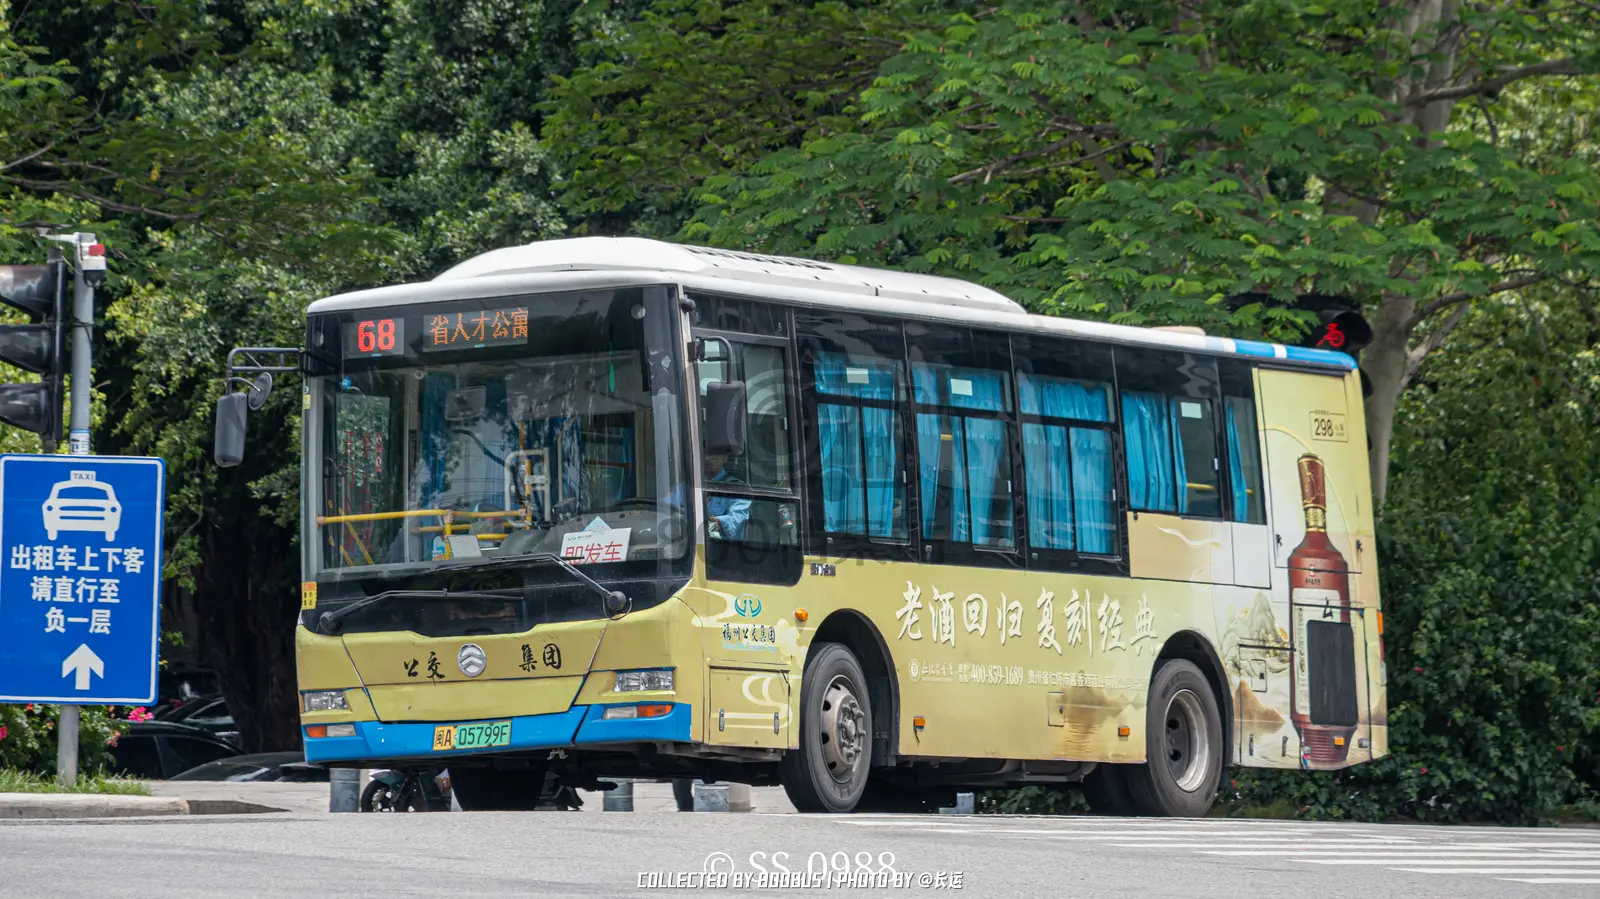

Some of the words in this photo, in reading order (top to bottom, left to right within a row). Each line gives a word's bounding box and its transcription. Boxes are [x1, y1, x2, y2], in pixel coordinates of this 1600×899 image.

[358, 319, 395, 352] 68
[429, 307, 528, 346] 省人才公寓
[1314, 418, 1333, 437] 298
[73, 472, 94, 480] TAXI
[10, 544, 145, 573] 出租车上下客
[565, 541, 622, 565] 即发车
[30, 575, 120, 603] 请直行至
[44, 606, 111, 635] 负一层
[722, 622, 776, 643] 福州公交集团
[403, 651, 446, 685] 公交
[518, 643, 562, 673] 集团
[971, 663, 1024, 686] 400-859-1689
[435, 728, 453, 748] 闽A
[458, 724, 509, 746] 05799F
